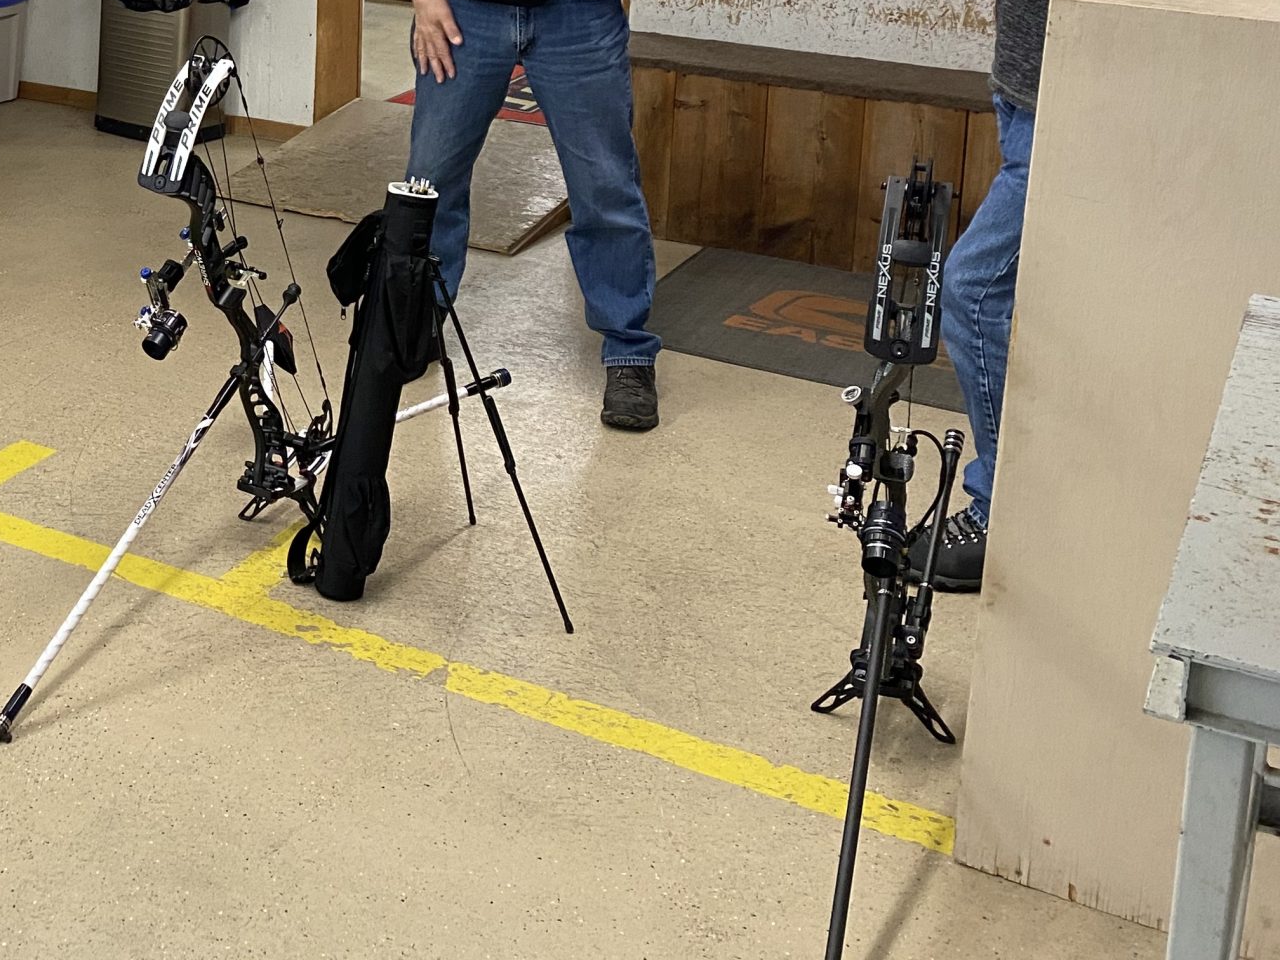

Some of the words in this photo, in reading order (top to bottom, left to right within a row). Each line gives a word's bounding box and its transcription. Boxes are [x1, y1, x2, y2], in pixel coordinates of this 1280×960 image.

[152, 78, 184, 145] PRIME
[180, 83, 213, 151] PRIME
[876, 243, 893, 298] NEXUS
[925, 251, 941, 306] NEXUS
[134, 501, 152, 526] DEAD
[155, 463, 177, 494] CENTER
